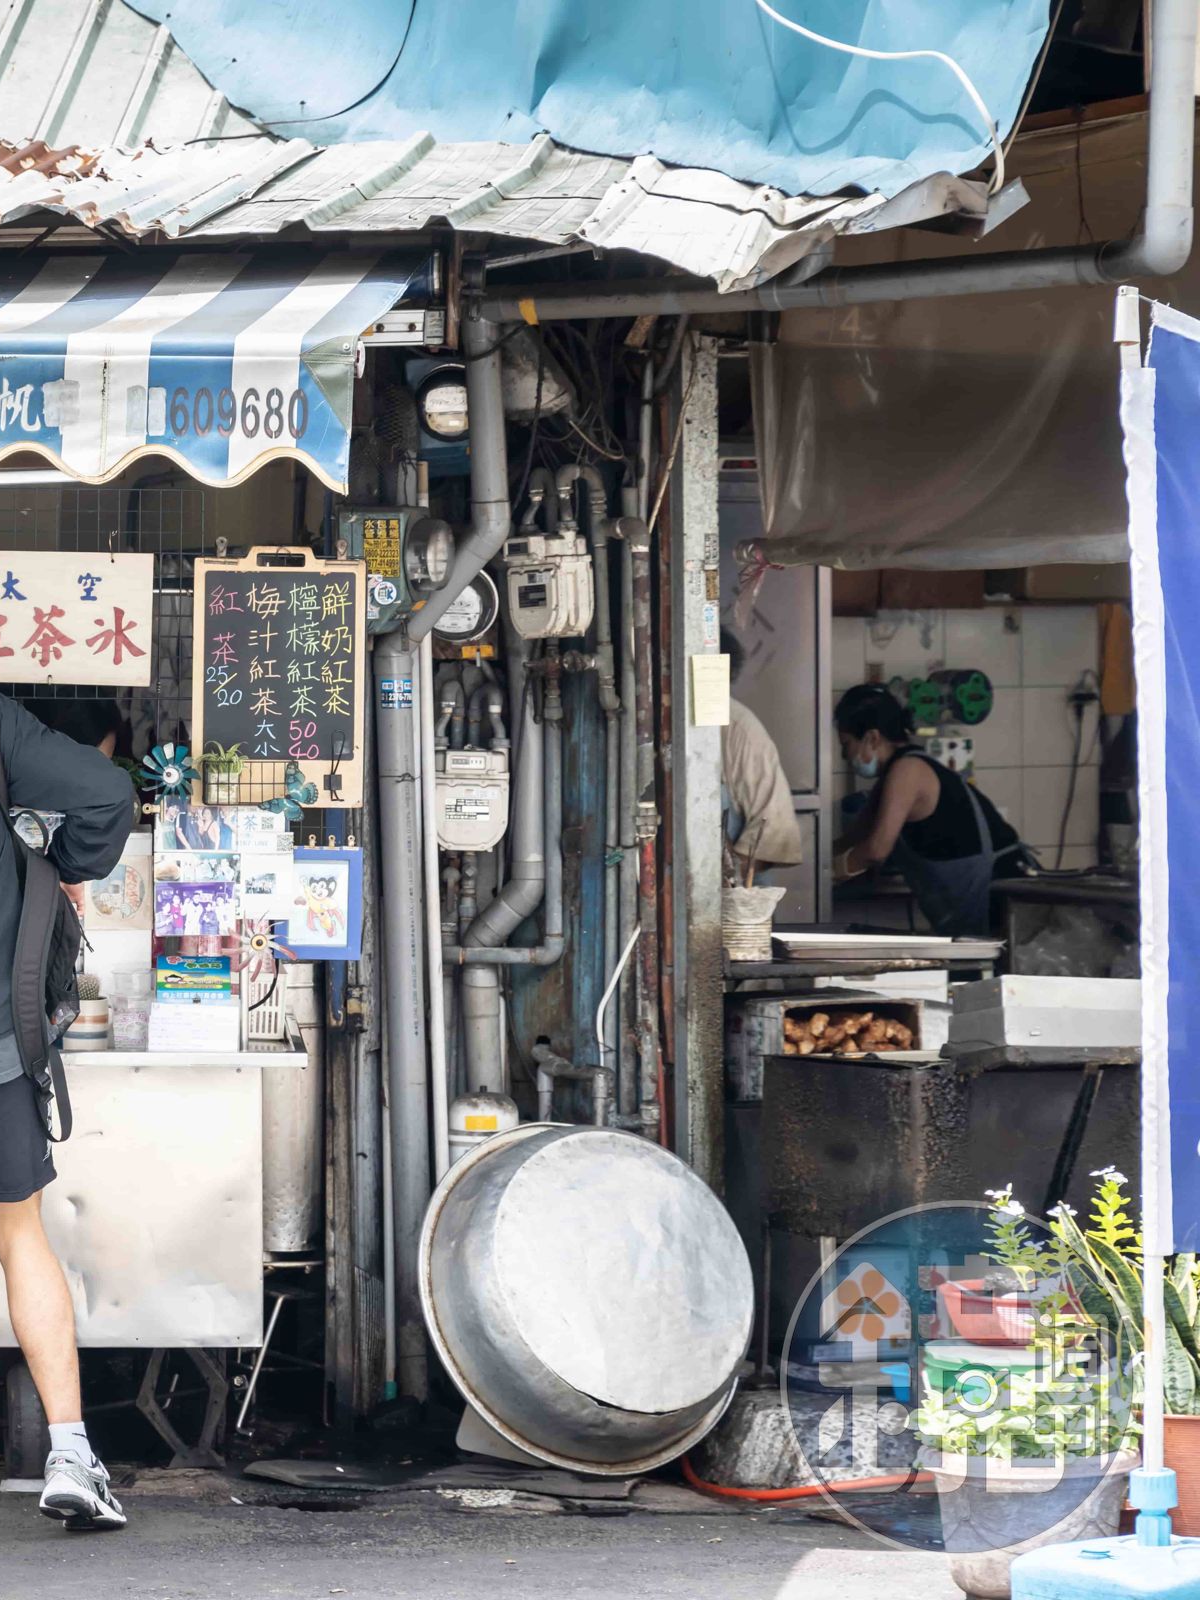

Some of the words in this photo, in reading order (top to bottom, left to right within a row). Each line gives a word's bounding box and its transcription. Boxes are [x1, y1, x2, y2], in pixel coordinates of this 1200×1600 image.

[321, 580, 353, 717] 鮮奶紅茶
[289, 720, 317, 741] 50
[288, 740, 320, 760] 40
